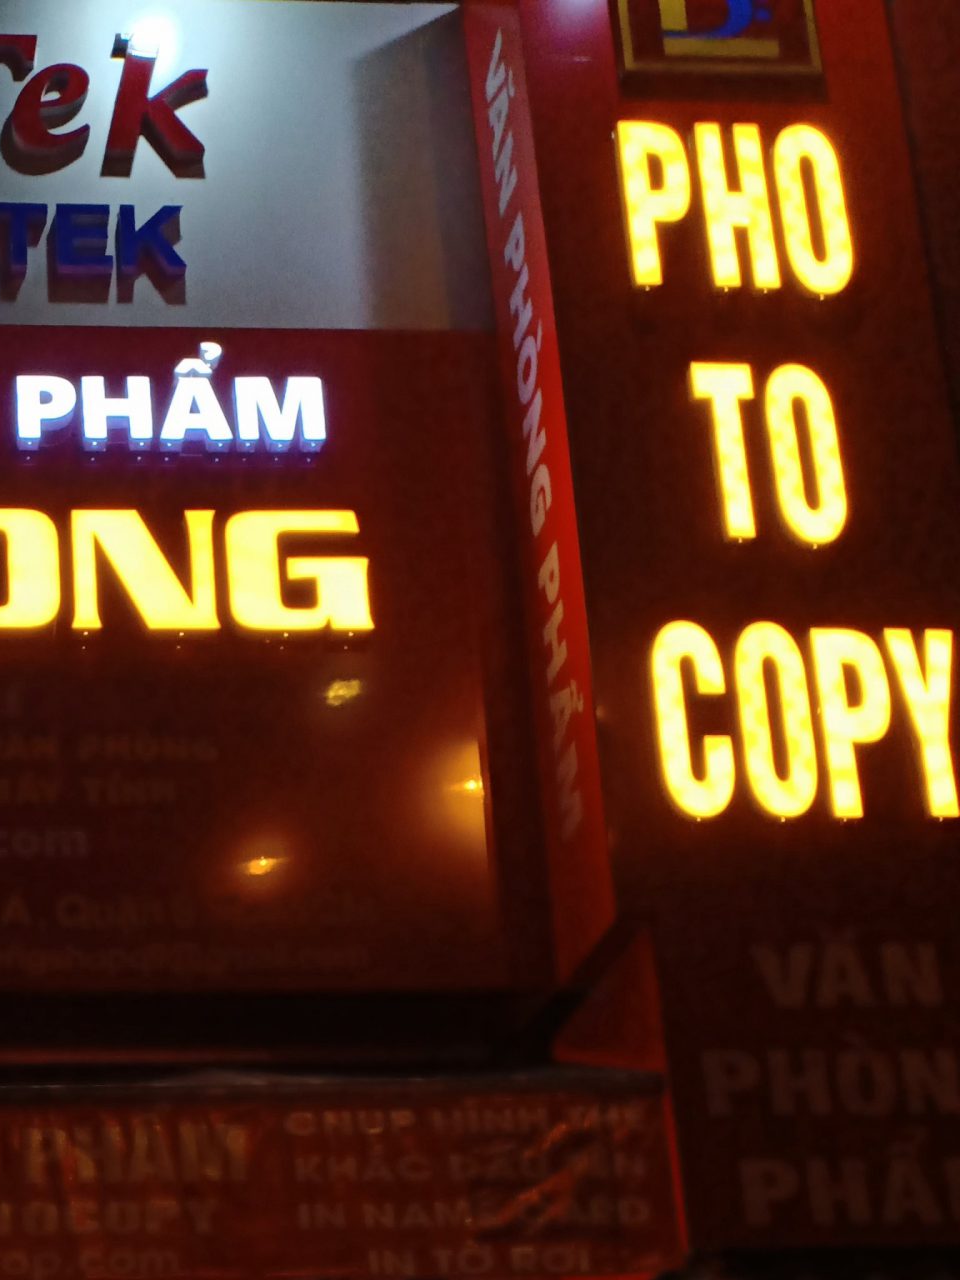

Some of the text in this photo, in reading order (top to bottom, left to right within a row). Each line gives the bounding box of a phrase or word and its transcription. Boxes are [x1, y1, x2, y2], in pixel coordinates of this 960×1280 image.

[616, 119, 856, 296] PHO
[485, 27, 519, 214] VĂN
[503, 220, 554, 537] PHÒNG
[13, 341, 328, 452] PHẨM
[688, 361, 850, 547] TO
[650, 619, 959, 820] COPY
[750, 922, 945, 1008] VĂN
[297, 1201, 348, 1231] IN
[367, 1248, 417, 1276] IN
